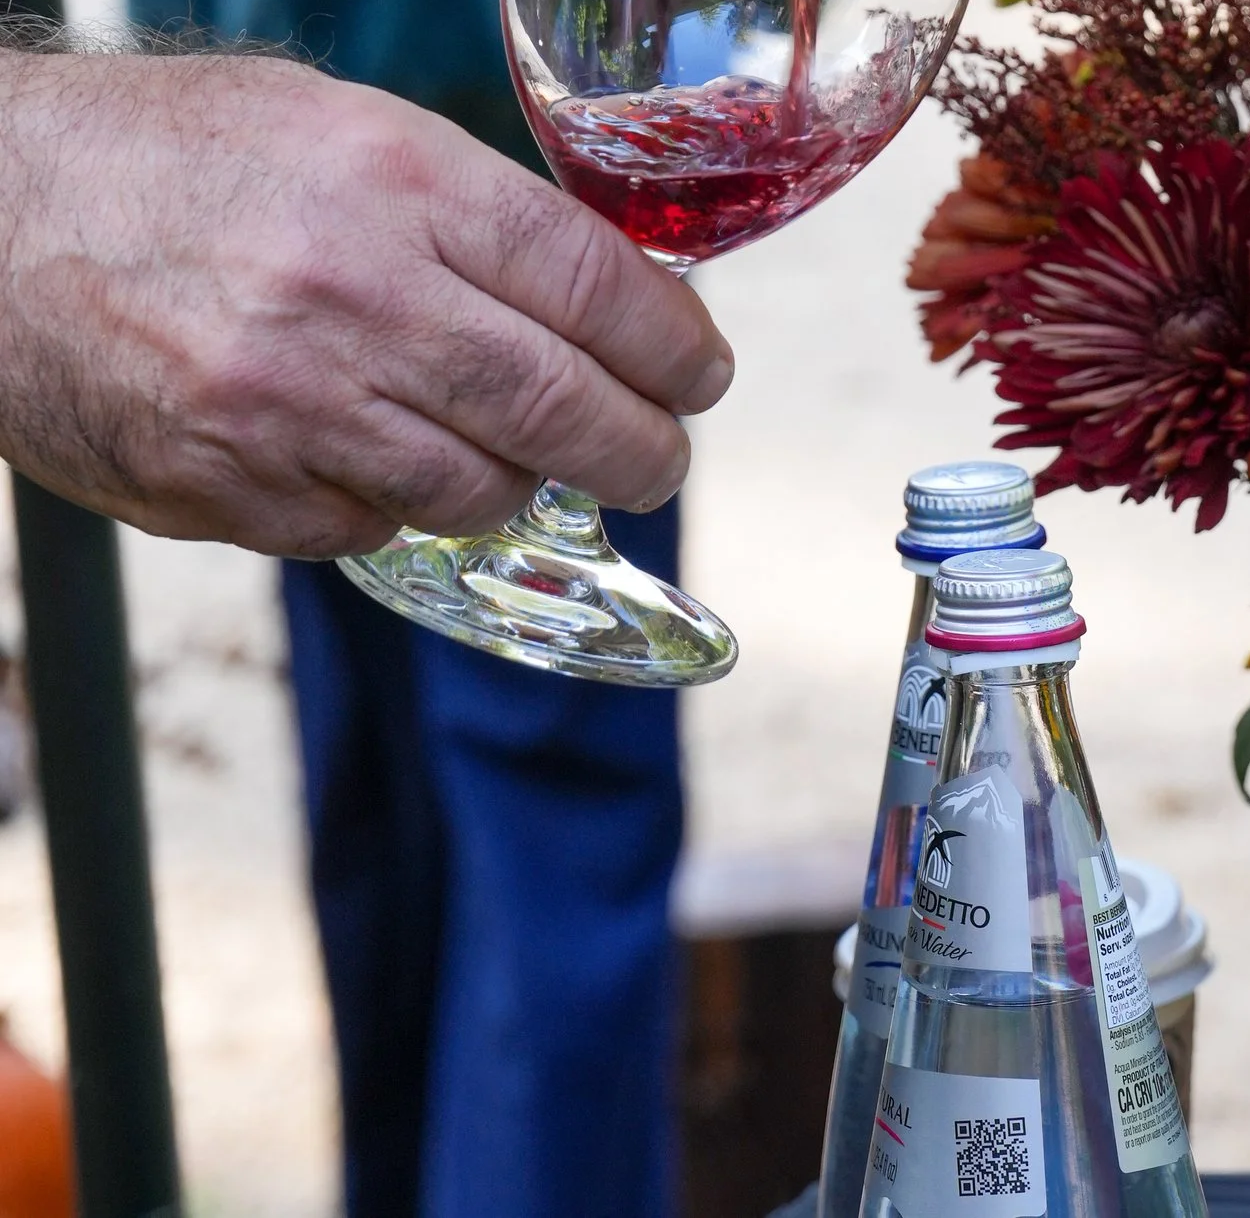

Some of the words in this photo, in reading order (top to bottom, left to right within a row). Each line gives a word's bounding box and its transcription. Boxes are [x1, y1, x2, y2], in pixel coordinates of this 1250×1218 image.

[916, 882, 991, 929] NEDETTO
[1092, 910, 1109, 925] BEST
[921, 929, 973, 961] Water
[1100, 941, 1122, 956] Serv.
[1105, 969, 1122, 981] Total
[1122, 965, 1131, 976] Fat
[1108, 991, 1125, 1003] Total
[1109, 1025, 1131, 1041] Analysis
[1114, 1036, 1135, 1051] Sodium
[1114, 1063, 1131, 1075] Acqua
[1122, 1065, 1150, 1085] PRODUCT
[1149, 1061, 1156, 1073] OF
[1118, 1086, 1135, 1113] CA
[1134, 1078, 1153, 1108] CRV
[1121, 1116, 1126, 1126] In
[1127, 1112, 1138, 1124] order
[1123, 1126, 1132, 1137] and
[1132, 1123, 1142, 1135] heat
